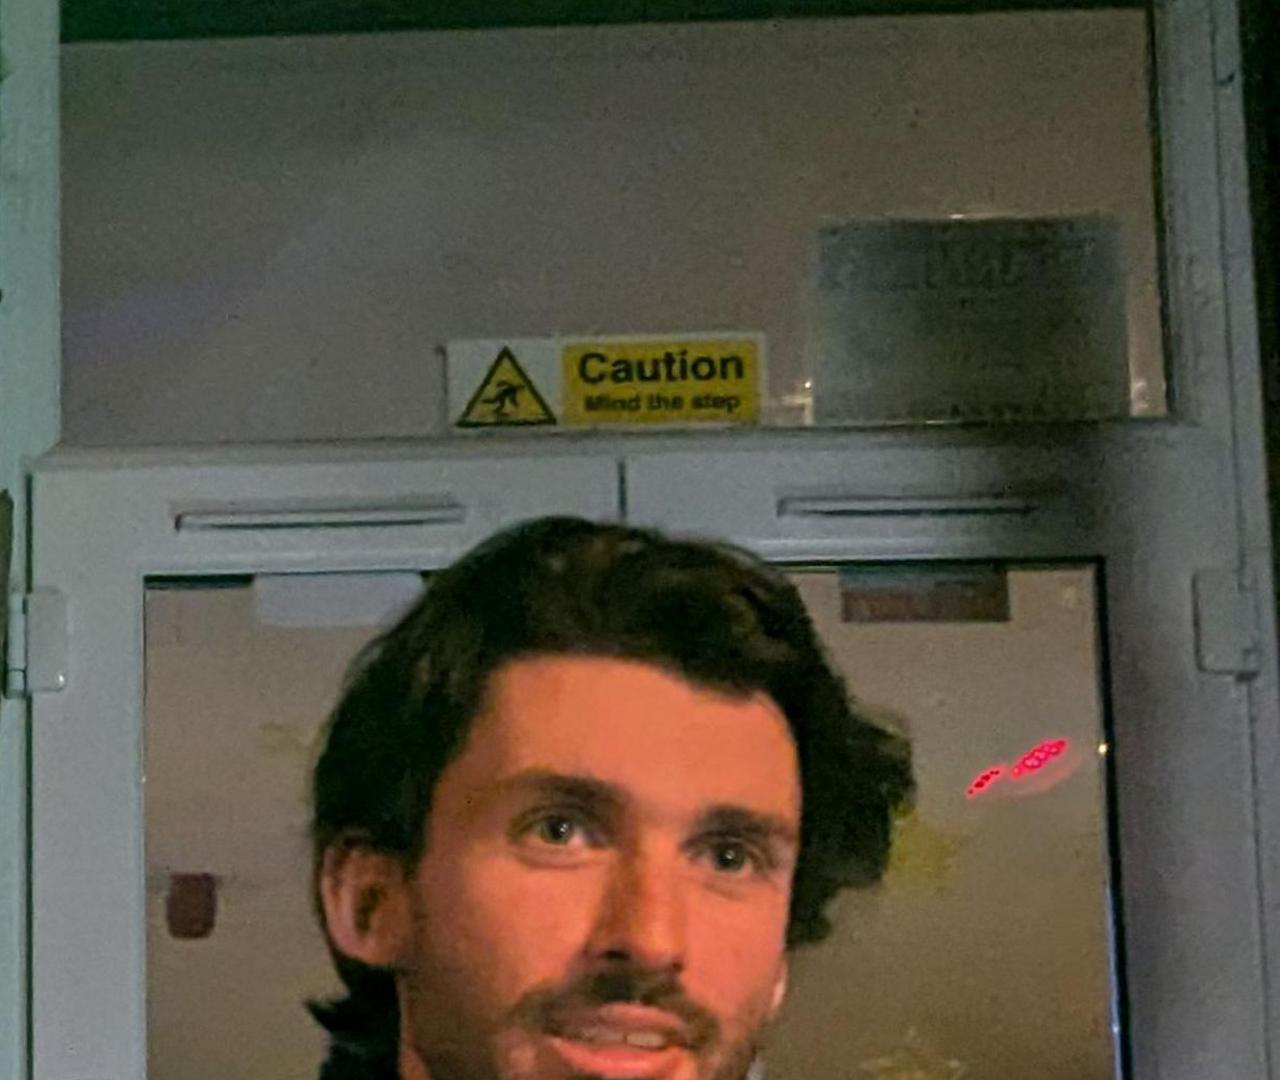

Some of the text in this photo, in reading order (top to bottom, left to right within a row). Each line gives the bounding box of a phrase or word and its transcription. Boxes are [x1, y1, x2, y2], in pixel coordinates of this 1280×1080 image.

[578, 350, 745, 385] Caution
[584, 393, 741, 414] Mind the step
